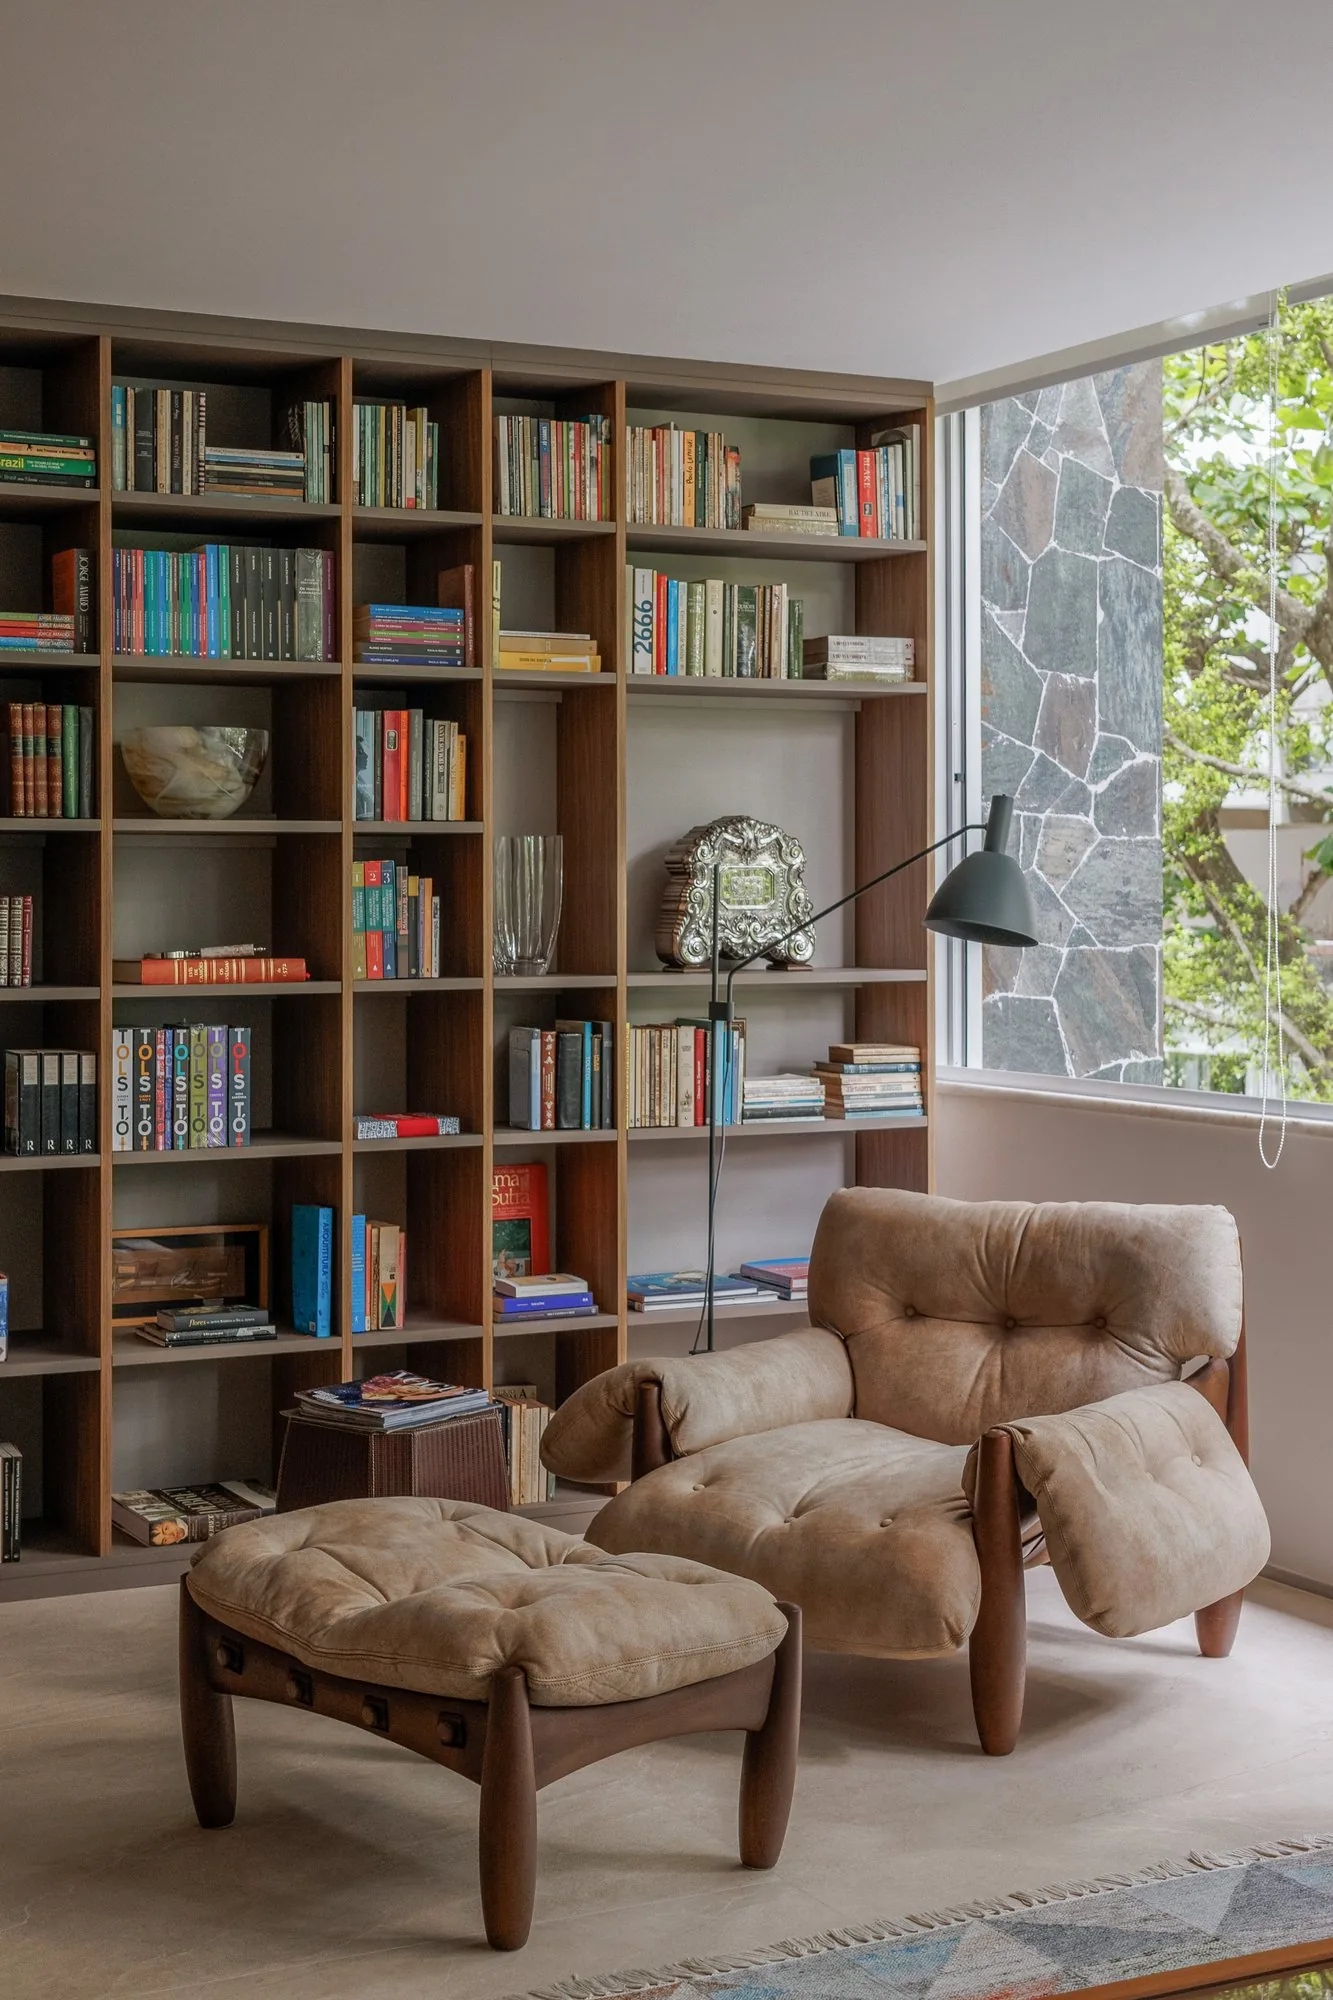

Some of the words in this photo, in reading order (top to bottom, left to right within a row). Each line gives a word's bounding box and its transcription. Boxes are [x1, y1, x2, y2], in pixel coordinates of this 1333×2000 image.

[0, 457, 24, 468] razil
[79, 555, 89, 581] JORGE
[79, 585, 89, 612] AMADO
[634, 600, 653, 655] 2666
[27, 1140, 34, 1151] R
[47, 1139, 54, 1150] R
[66, 1139, 73, 1149] R
[85, 1139, 92, 1149] R
[493, 1174, 519, 1187] ma
[492, 1187, 530, 1205] Sutra
